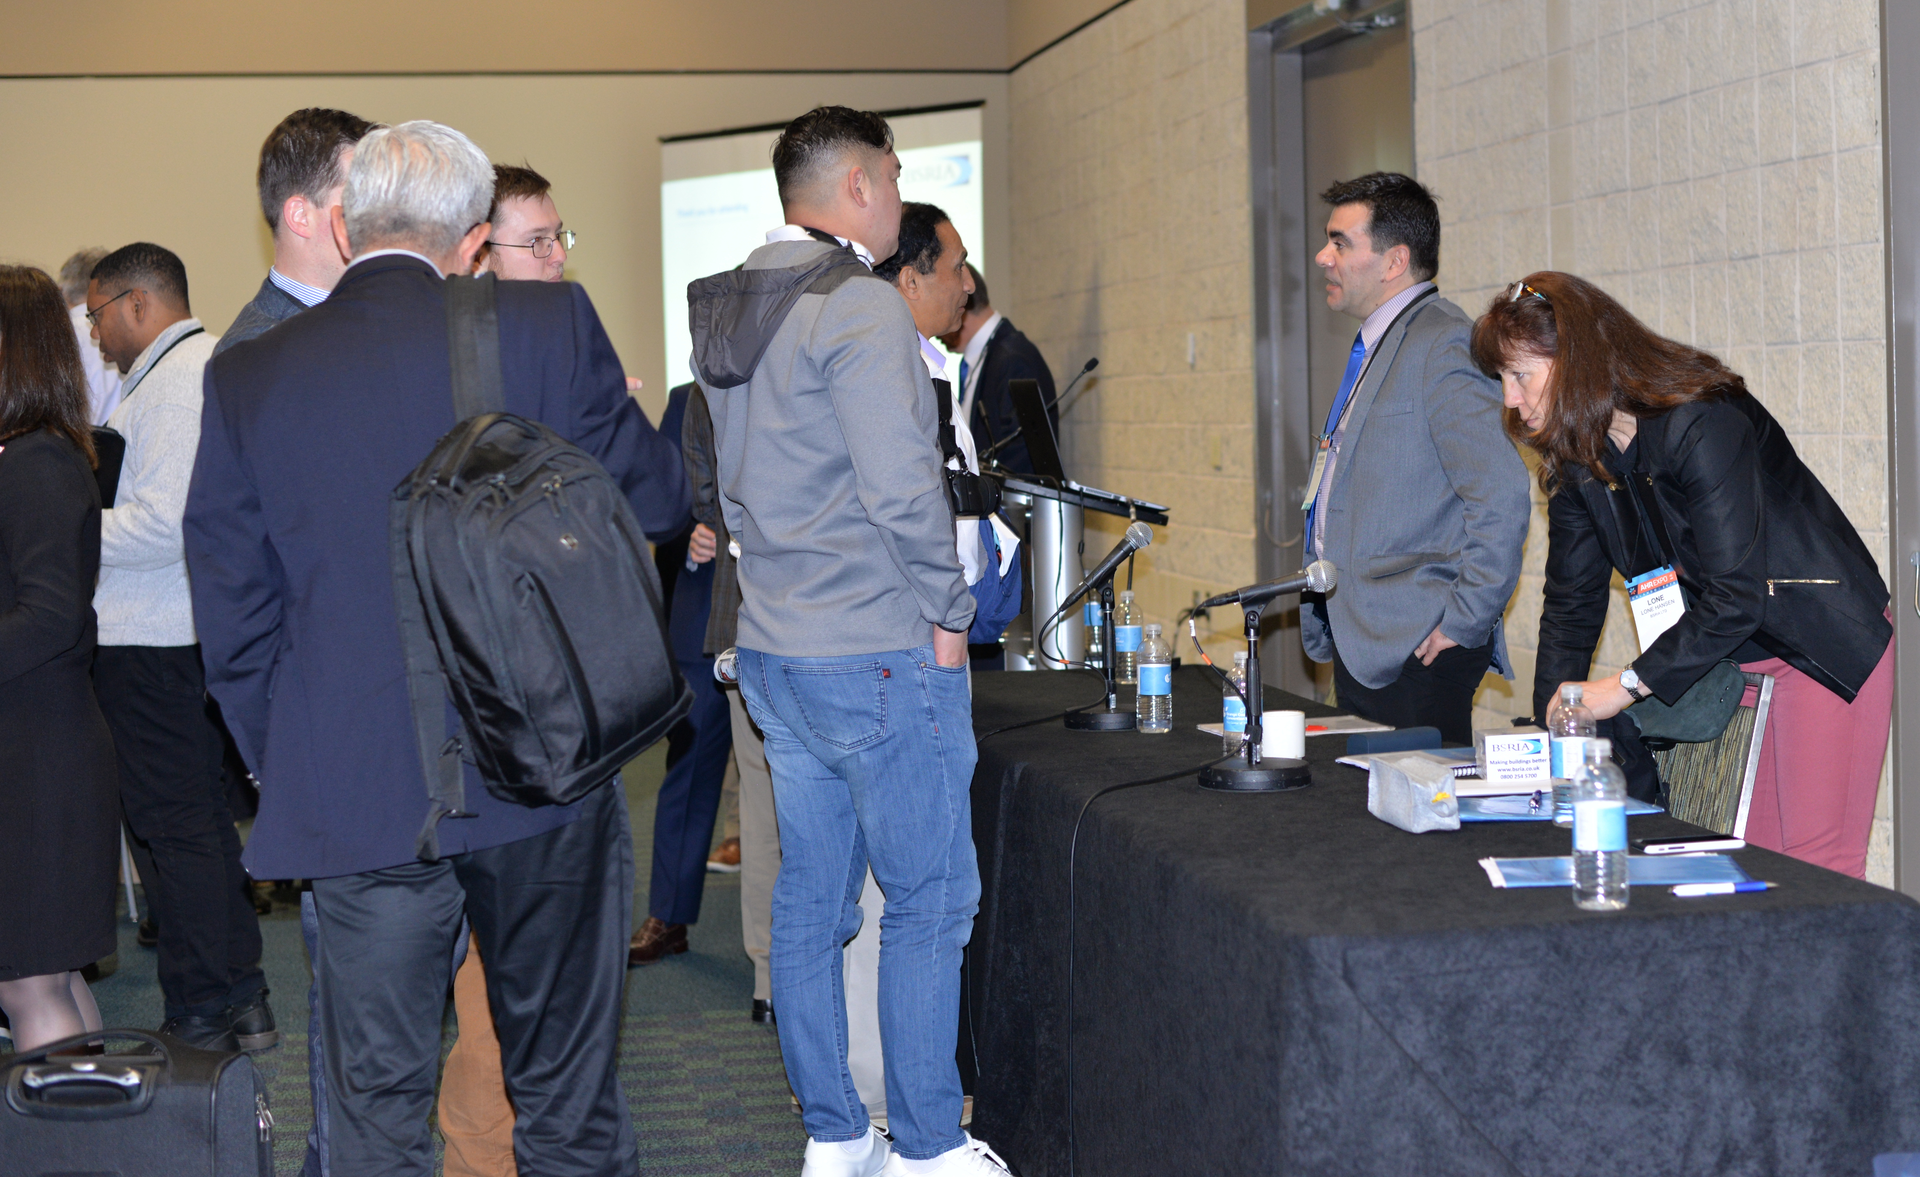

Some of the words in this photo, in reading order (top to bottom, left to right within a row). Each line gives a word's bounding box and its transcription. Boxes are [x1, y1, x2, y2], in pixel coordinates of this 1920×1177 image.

[1647, 594, 1665, 606] LONE
[1640, 606, 1654, 616] LONE
[1654, 599, 1676, 610] HANSEN
[1492, 743, 1530, 752] BSRIA
